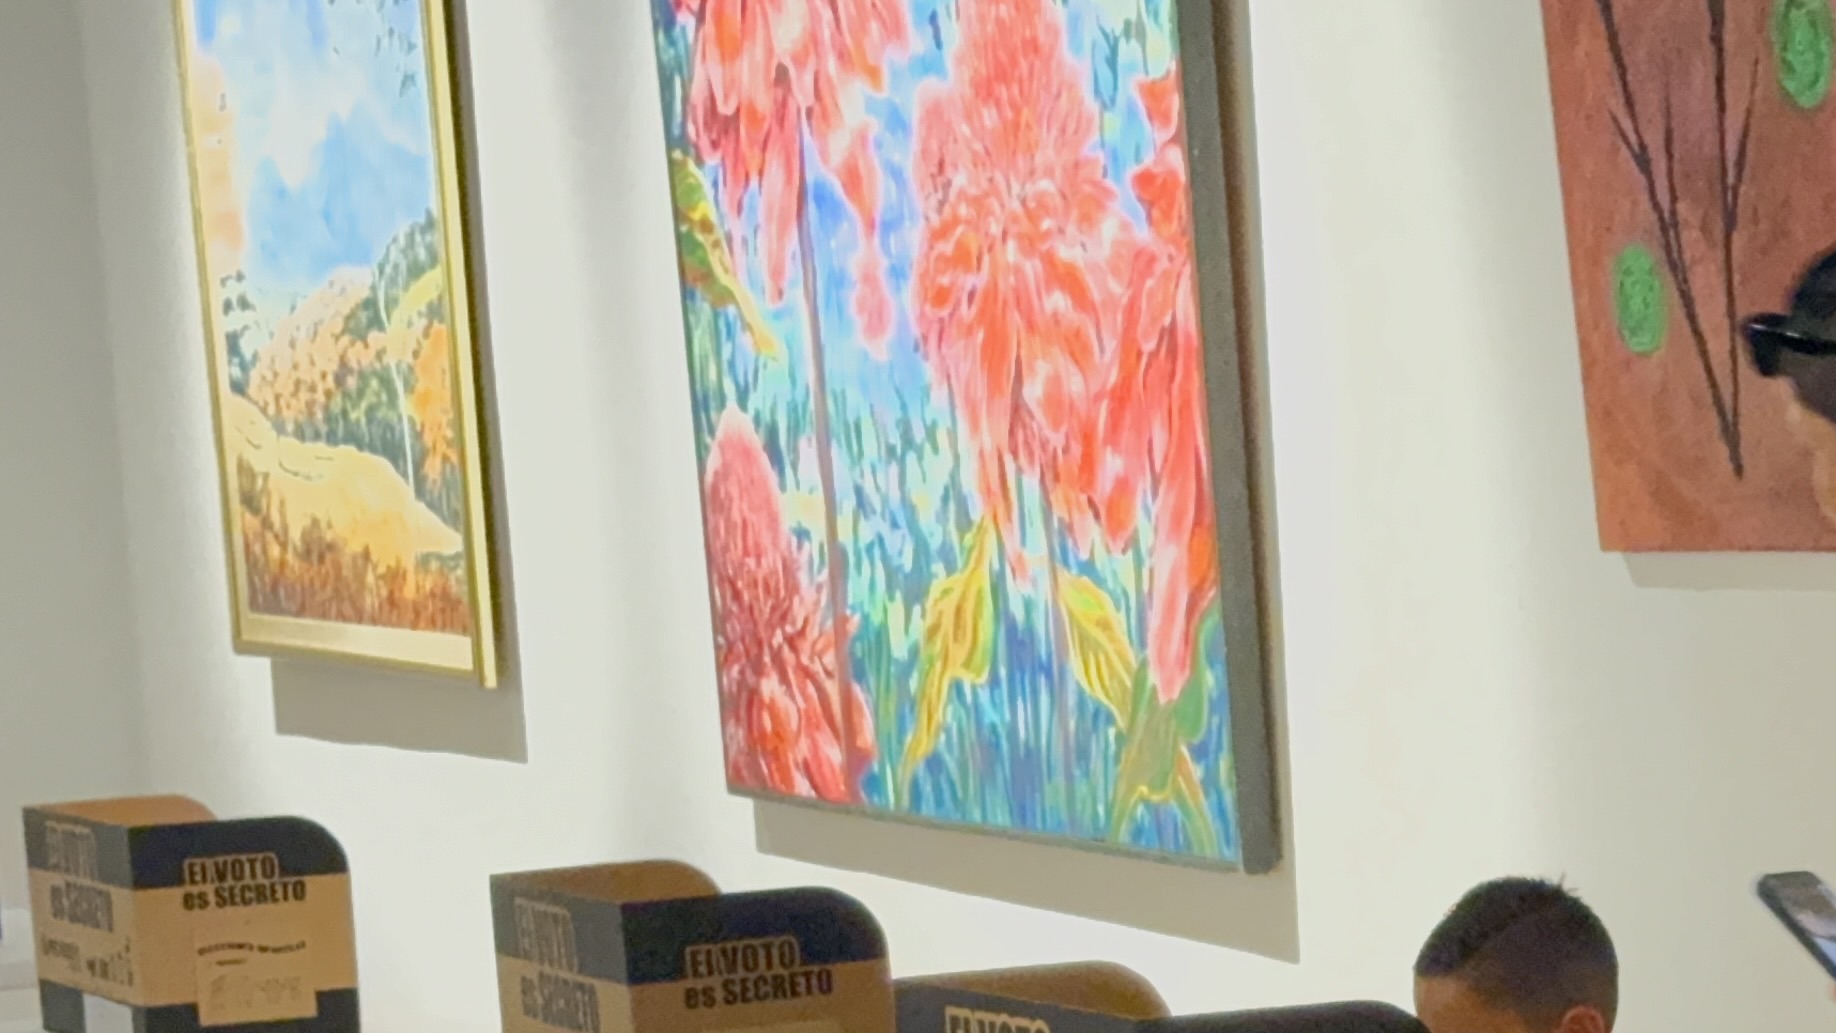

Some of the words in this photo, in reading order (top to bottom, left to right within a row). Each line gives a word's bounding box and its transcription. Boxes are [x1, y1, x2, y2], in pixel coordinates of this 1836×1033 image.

[214, 856, 275, 883] VOTO
[183, 892, 209, 911] es
[214, 880, 306, 908] SECRETO
[720, 939, 796, 975] VOTO
[685, 986, 716, 1010] es
[722, 968, 833, 1005] SECRETO
